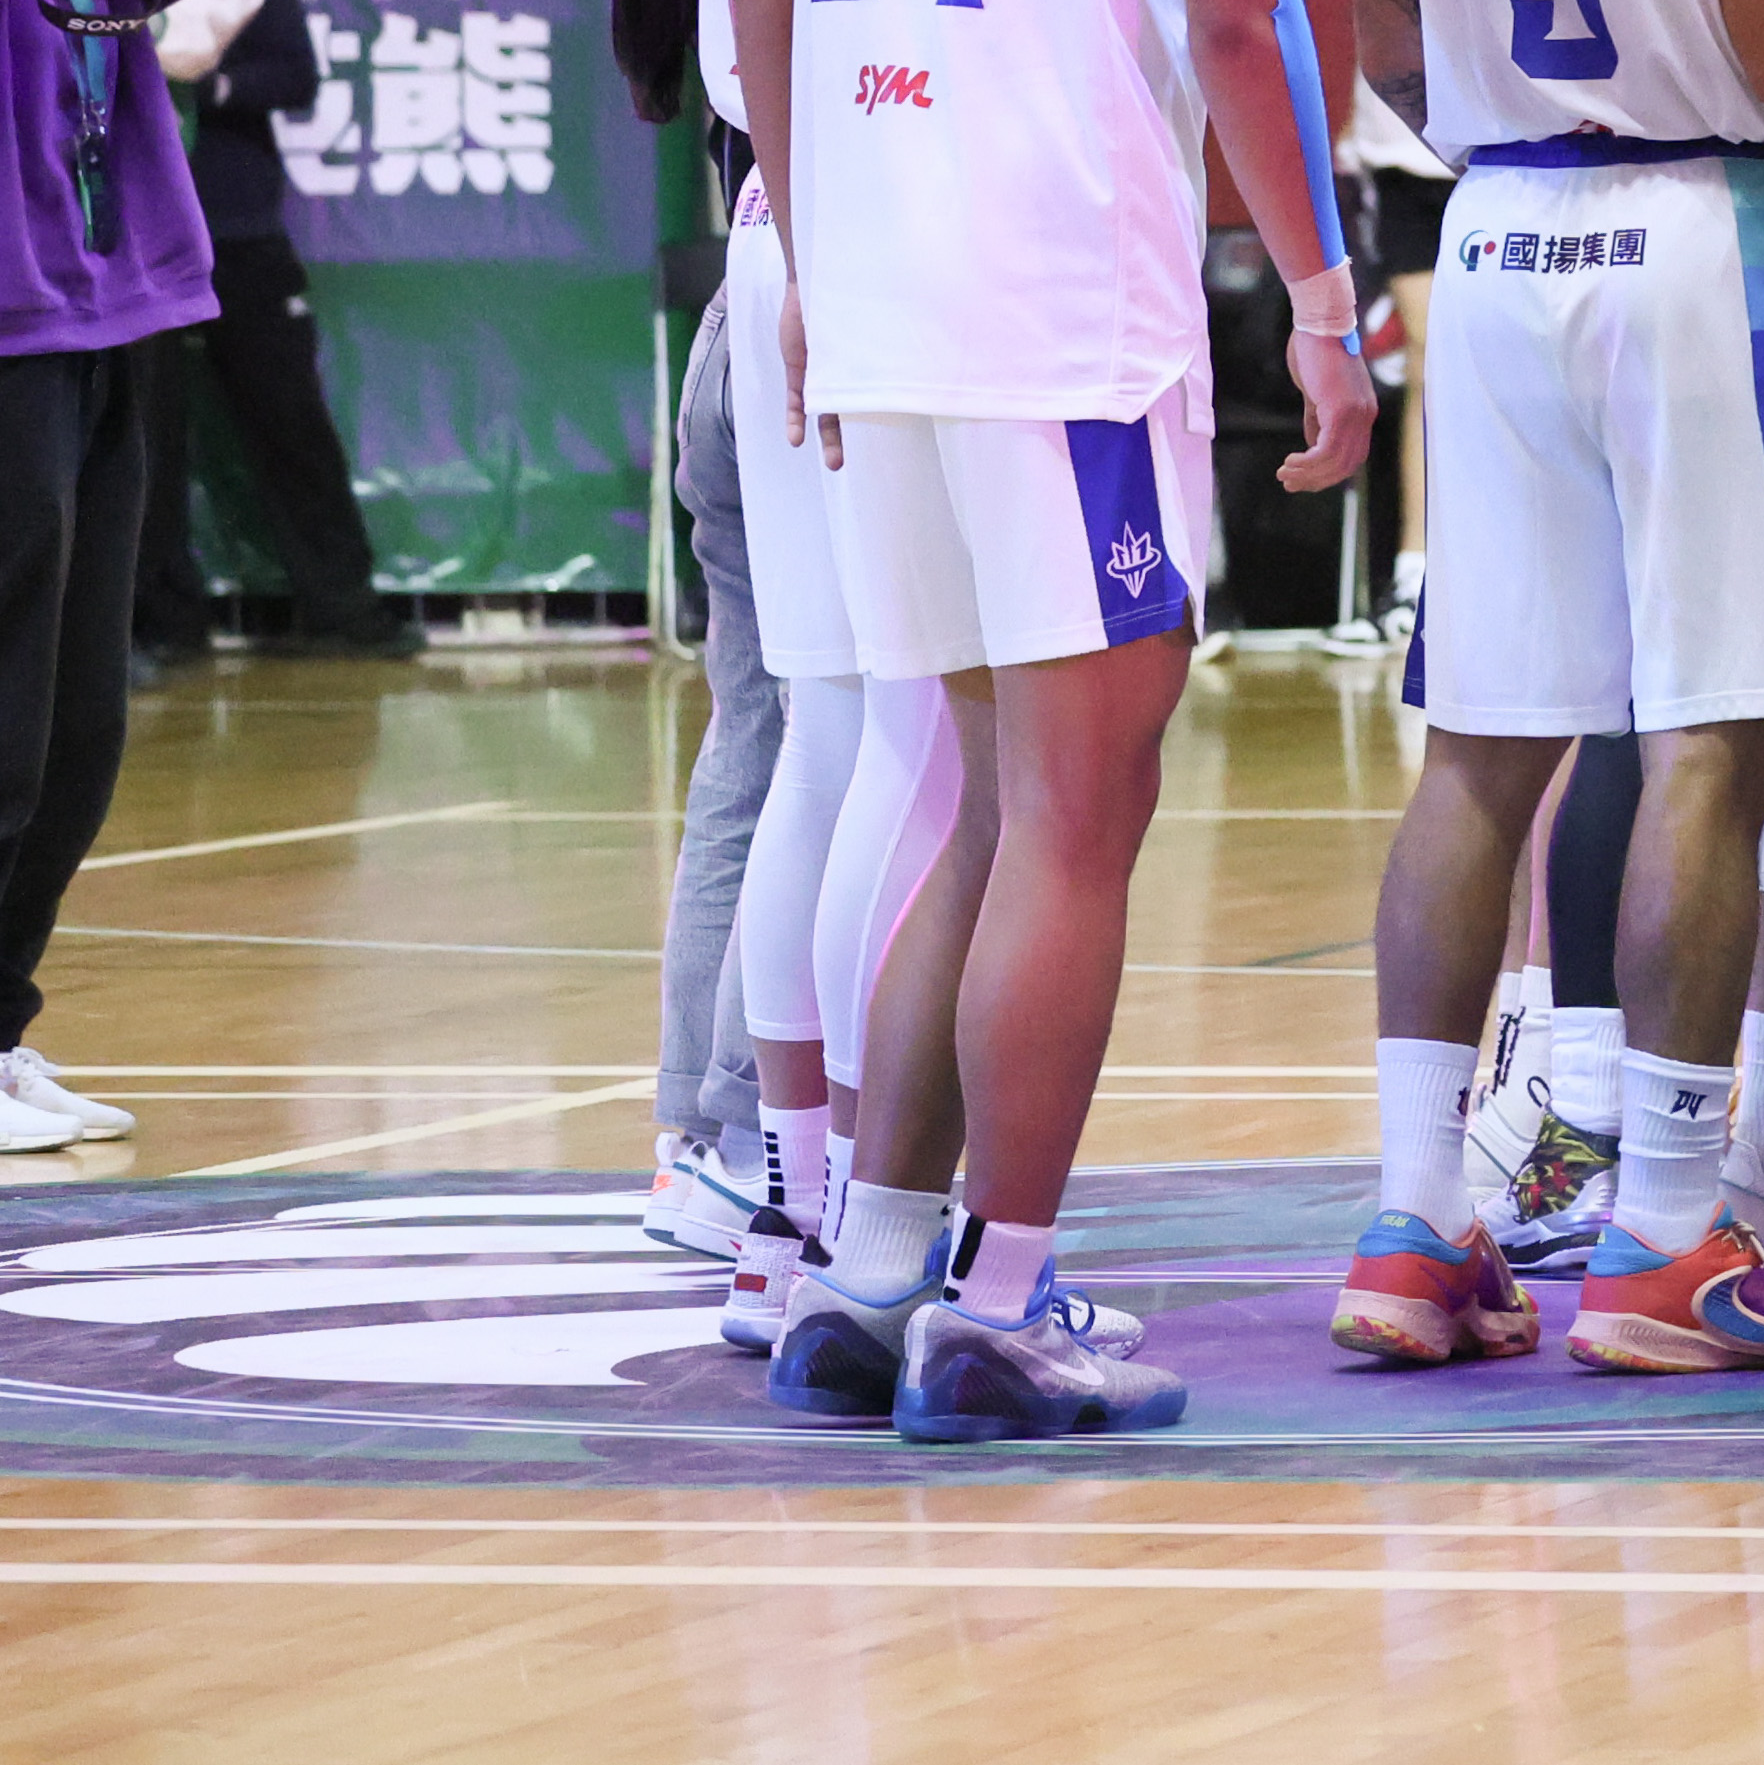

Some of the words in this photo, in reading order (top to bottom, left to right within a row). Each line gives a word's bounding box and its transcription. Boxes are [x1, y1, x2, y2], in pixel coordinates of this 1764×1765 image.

[66, 16, 143, 34] SONY
[855, 65, 934, 116] SYM
[1500, 228, 1647, 274] 國揚集團
